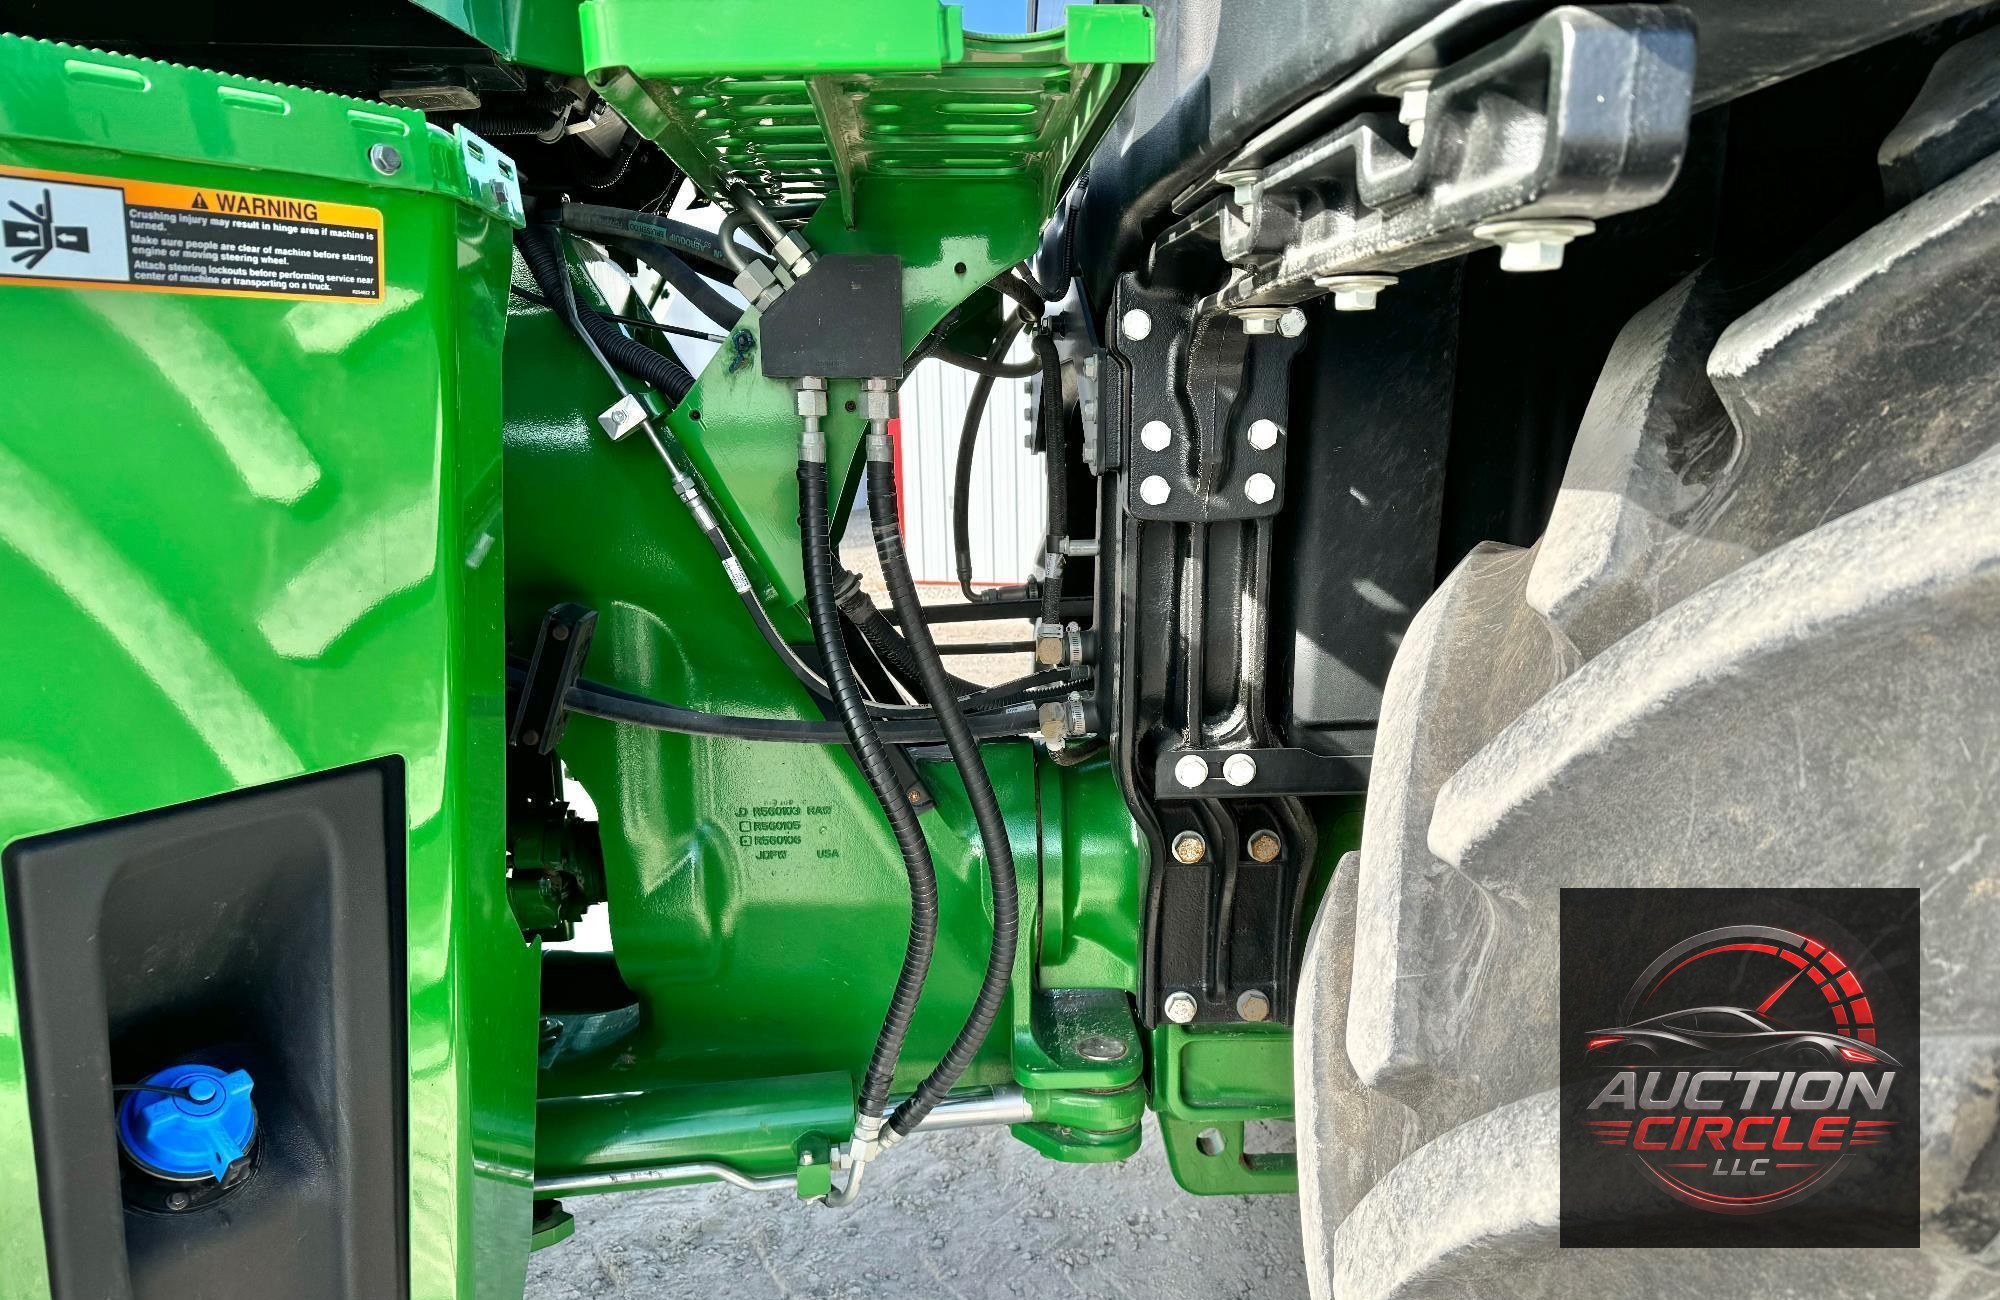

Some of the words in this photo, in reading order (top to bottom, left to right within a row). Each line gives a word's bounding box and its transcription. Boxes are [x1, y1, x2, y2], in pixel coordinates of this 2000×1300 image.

[216, 193, 318, 221] WARNING
[129, 208, 177, 224] Crushing
[178, 213, 208, 226] injury
[210, 217, 230, 229] may
[232, 220, 260, 230] result
[262, 222, 271, 230] in
[273, 223, 298, 234] hinge
[300, 226, 320, 235] area
[321, 227, 328, 236] if
[330, 229, 364, 240] machine
[366, 232, 374, 240] is
[130, 220, 168, 232] turned.
[131, 234, 158, 245] Make
[160, 238, 184, 247] sure
[185, 240, 218, 251] people
[220, 242, 236, 251] are
[238, 244, 260, 253] clear
[262, 246, 272, 254] of
[274, 248, 312, 257] machine
[313, 250, 340, 260] before
[342, 252, 374, 264] starting
[669, 233, 706, 251] AEROQUIP
[132, 246, 168, 257] engine
[168, 249, 180, 257] or
[182, 250, 218, 262] moving
[220, 252, 259, 265] steering
[260, 256, 290, 265] wheel.
[134, 260, 166, 270] Attach
[168, 262, 207, 275] steering
[208, 265, 248, 276] lockouts
[248, 268, 278, 278] before
[279, 270, 325, 282] performing
[326, 274, 355, 283] service
[134, 272, 166, 281] center
[168, 272, 178, 281] of
[180, 274, 220, 284] machine
[220, 276, 232, 285] or
[232, 277, 287, 290] transporting
[301, 282, 308, 290] a
[308, 282, 332, 291] truck.
[816, 850, 840, 859] USA
